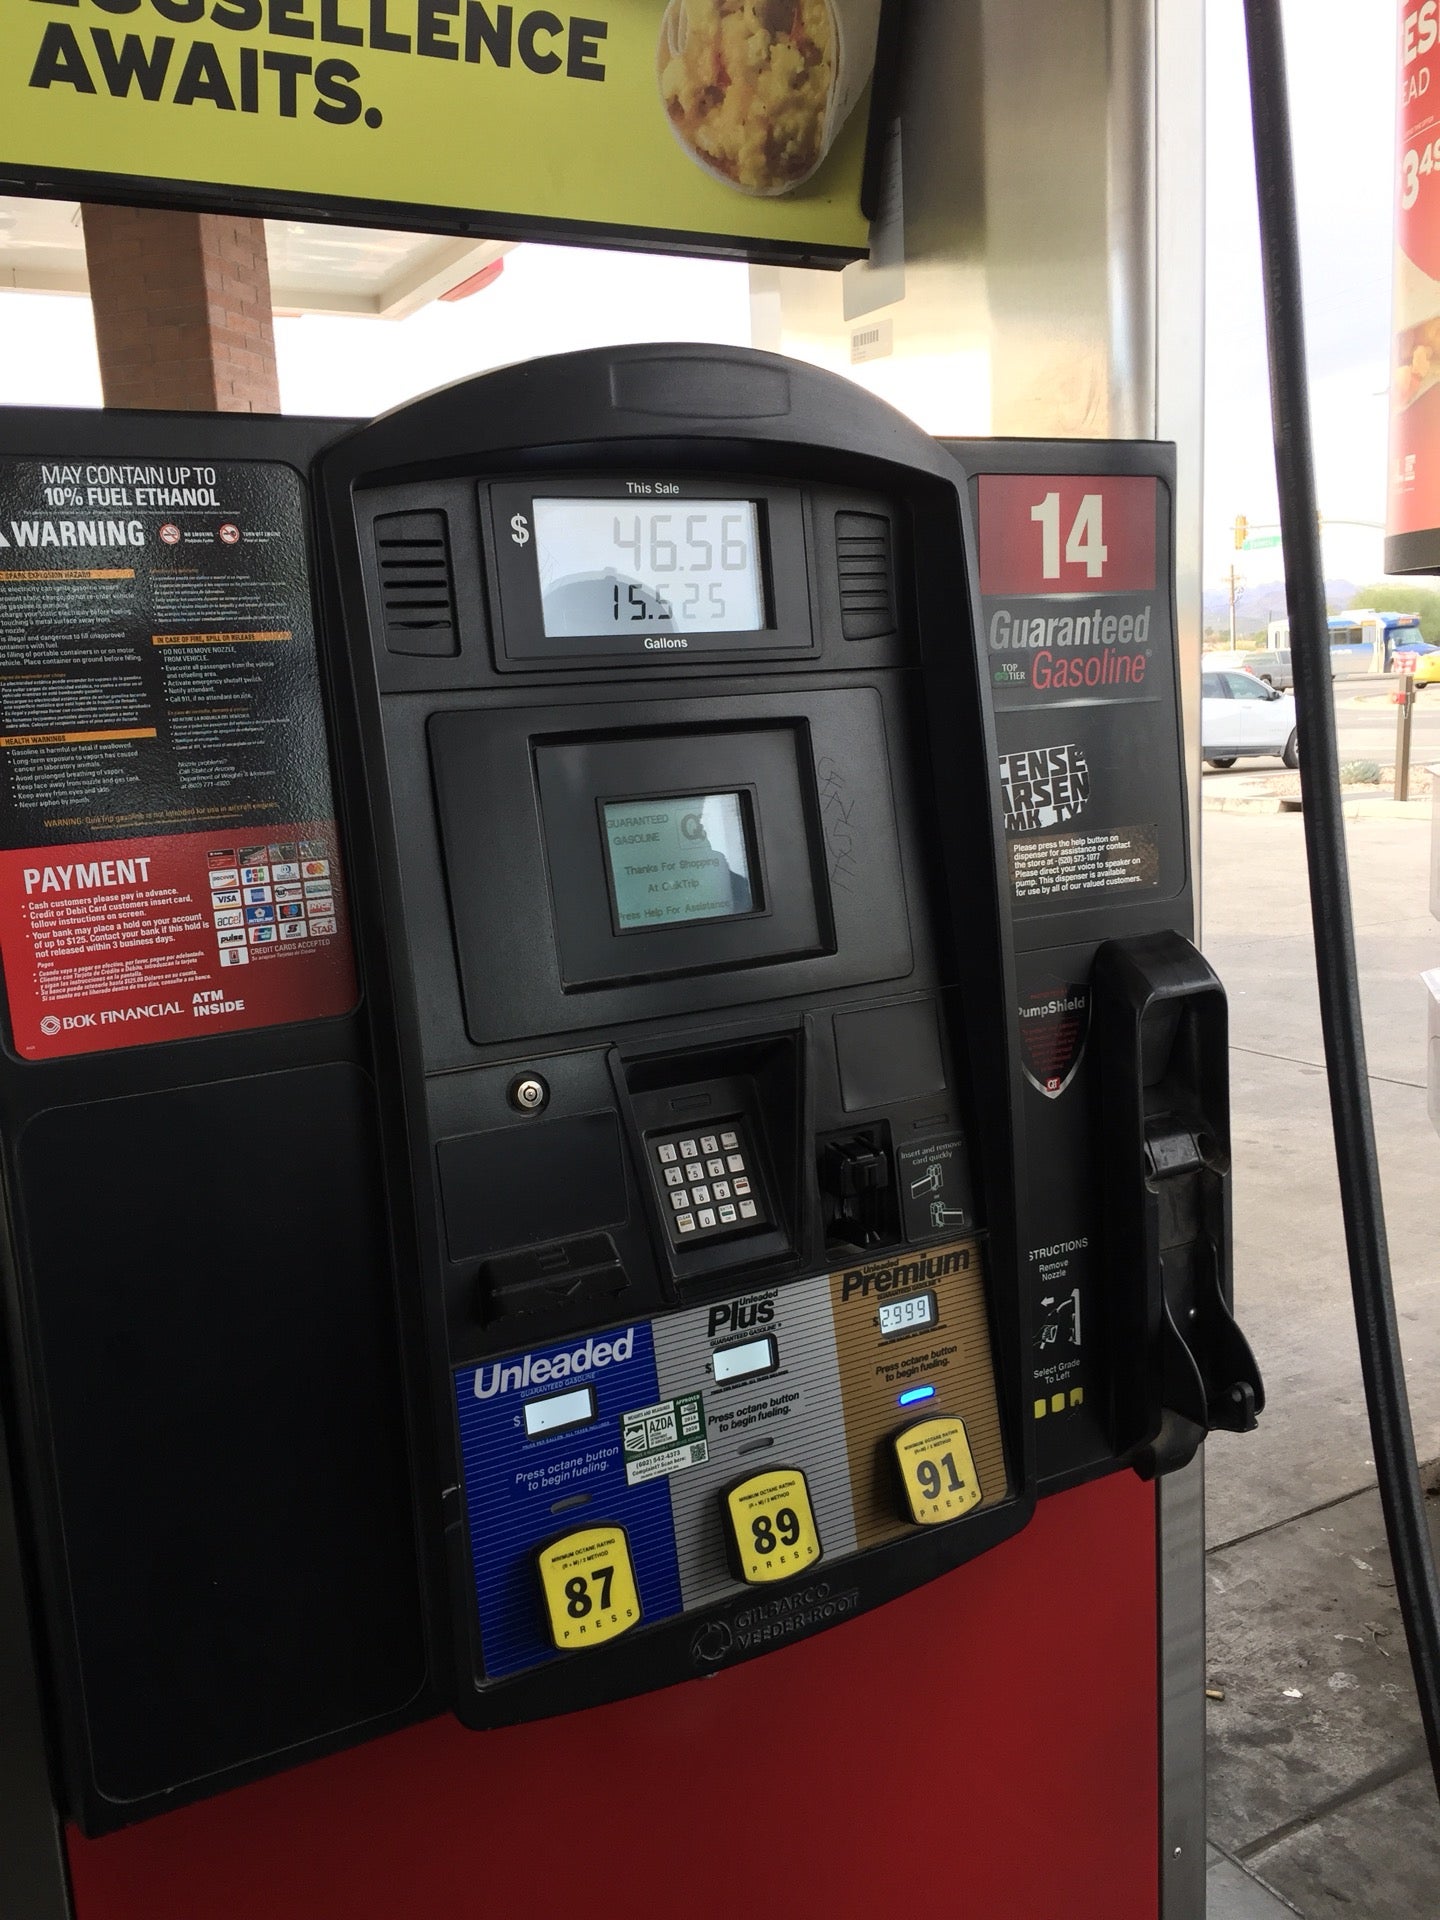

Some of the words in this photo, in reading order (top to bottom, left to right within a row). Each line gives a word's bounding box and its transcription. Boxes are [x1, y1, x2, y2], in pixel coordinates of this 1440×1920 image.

[28, 21, 382, 129] AWAITS.
[41, 465, 82, 484] MAY
[86, 466, 166, 485] CONTAIN
[169, 467, 191, 484] UP
[195, 467, 216, 485] TO
[44, 487, 84, 506] 10%
[87, 487, 134, 506] FUEL
[136, 487, 220, 507] ETHANOL
[626, 482, 652, 494] This
[655, 482, 680, 495] Sale
[11, 520, 145, 547] WARNING
[1031, 492, 1108, 579] 14
[989, 605, 1151, 650] Guaranteed
[644, 637, 688, 650] Gallons
[1002, 663, 1018, 672] TOP
[1008, 671, 1026, 680] TIER
[1032, 648, 1146, 689] Gasoline
[606, 814, 669, 829] GUARANTEED
[613, 832, 660, 846] GASOLINE
[1013, 844, 1037, 852] Please
[1038, 842, 1057, 851] press
[1071, 838, 1085, 846] help
[1086, 836, 1108, 844] button
[1014, 850, 1048, 861] dispenser
[1060, 845, 1096, 855] assistance
[1106, 841, 1131, 850] contact
[624, 863, 659, 875] Thanks
[661, 862, 676, 871] For
[679, 858, 719, 870] Shopping
[1014, 861, 1026, 869] the
[1027, 860, 1046, 868] store
[23, 857, 151, 894] PAYMENT
[648, 883, 659, 893] At
[28, 901, 48, 910] Cash
[50, 897, 92, 907] customers
[93, 894, 119, 904] please
[120, 893, 134, 902] pay
[136, 890, 143, 898] in
[145, 888, 179, 897] advance.
[30, 911, 54, 920] Credit
[66, 907, 87, 915] Debit
[88, 904, 107, 913] Card
[108, 899, 149, 911] customers
[150, 897, 172, 906] insert
[217, 895, 237, 903] VISA
[31, 920, 57, 929] follow
[58, 914, 105, 925] instructions
[118, 910, 147, 918] screen.
[644, 907, 663, 918] Help
[666, 905, 680, 914] For
[32, 931, 51, 940] Your
[52, 928, 73, 938] bank
[74, 927, 91, 935] may
[93, 924, 115, 934] place
[123, 920, 140, 929] hold
[153, 917, 170, 926] your
[172, 913, 202, 922] account
[34, 940, 42, 949] of
[44, 940, 55, 948] up
[56, 938, 65, 946] to
[66, 936, 88, 945] $125.
[89, 932, 120, 942] Contact
[121, 931, 139, 940] your
[140, 927, 160, 936] bank
[168, 924, 183, 933] this
[184, 922, 201, 931] hold
[202, 921, 210, 929] is
[311, 924, 335, 935] STAR
[35, 950, 49, 958] not
[50, 946, 85, 956] released
[86, 942, 111, 952] within
[112, 941, 118, 949] 3
[119, 937, 154, 947] business
[155, 935, 175, 944] days.
[250, 945, 273, 955] CREDIT
[275, 942, 297, 952] CARDS
[298, 939, 331, 949] ACCEPTED
[192, 989, 224, 1004] ATM
[62, 1013, 97, 1030] BOK
[101, 1001, 184, 1025] FINANCIAL
[193, 1000, 245, 1017] INSIDE
[842, 1249, 970, 1301] Premium
[1039, 1260, 1069, 1273] Remove
[1042, 1269, 1067, 1282] Nozzle
[739, 1289, 779, 1306] Unleaded
[707, 1299, 775, 1338] Plus
[473, 1327, 635, 1399] Unleaded
[875, 1362, 899, 1375] Press
[901, 1353, 929, 1367] octane
[930, 1345, 958, 1360] button
[1033, 1365, 1057, 1379] Select
[1058, 1359, 1081, 1371] Grade
[885, 1372, 894, 1382] to
[896, 1366, 919, 1381] begin
[1045, 1375, 1054, 1384] To
[1055, 1371, 1071, 1382] Left
[708, 1412, 735, 1426] Press
[736, 1402, 768, 1417] octane
[769, 1392, 800, 1408] button
[719, 1421, 729, 1432] to
[730, 1414, 757, 1431] begin
[757, 1405, 792, 1424] fueling.
[648, 1415, 674, 1434] AZDA
[515, 1469, 545, 1484] Press
[547, 1458, 583, 1474] octane
[585, 1446, 619, 1463] button
[527, 1480, 538, 1491] to
[541, 1472, 570, 1490] begin
[571, 1461, 610, 1482] fueling.
[916, 1452, 966, 1500] 91
[751, 1507, 800, 1555] 89
[564, 1565, 615, 1619] 87
